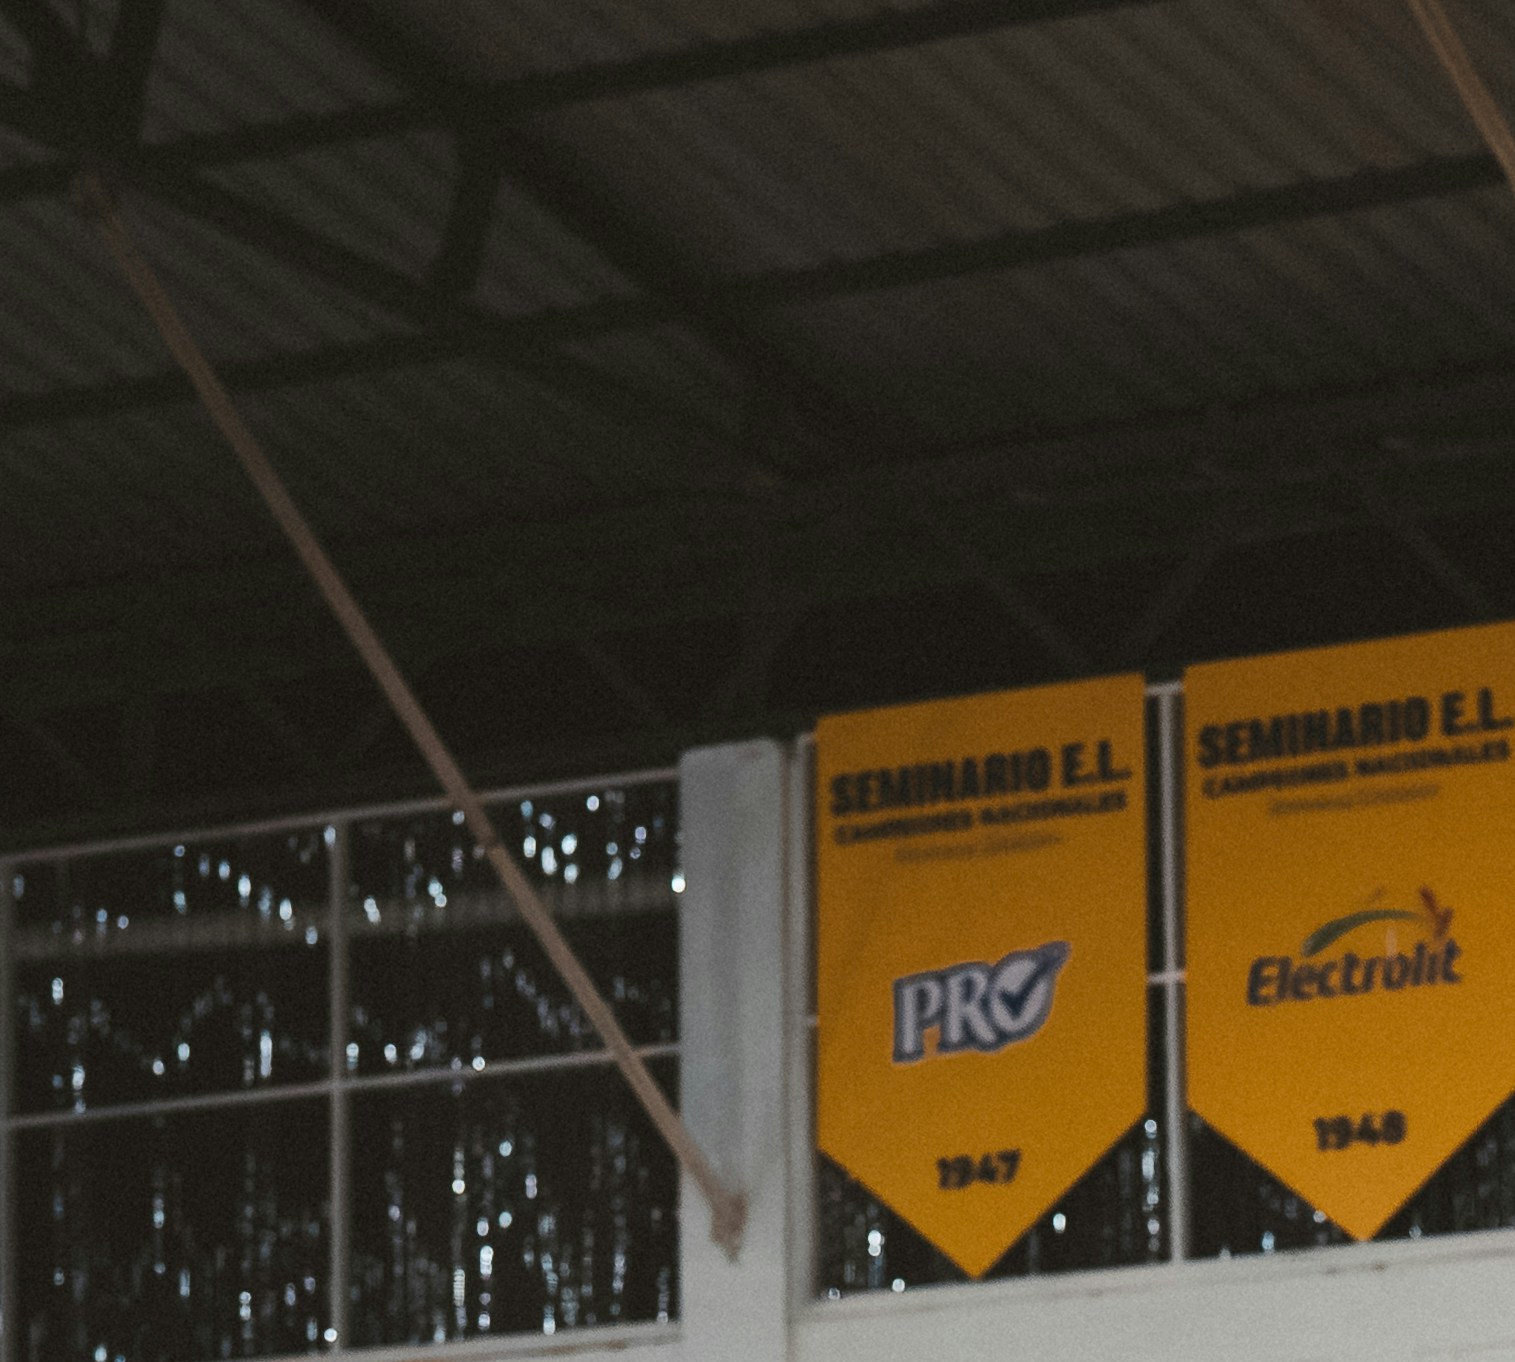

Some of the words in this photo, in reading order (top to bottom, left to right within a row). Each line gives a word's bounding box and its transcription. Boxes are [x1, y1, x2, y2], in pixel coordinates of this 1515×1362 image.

[1199, 696, 1431, 769] SEMINARIO
[830, 746, 1050, 816] SEMINARIO
[1247, 938, 1462, 1007] Electrolit
[936, 1148, 1021, 1191] 1947
